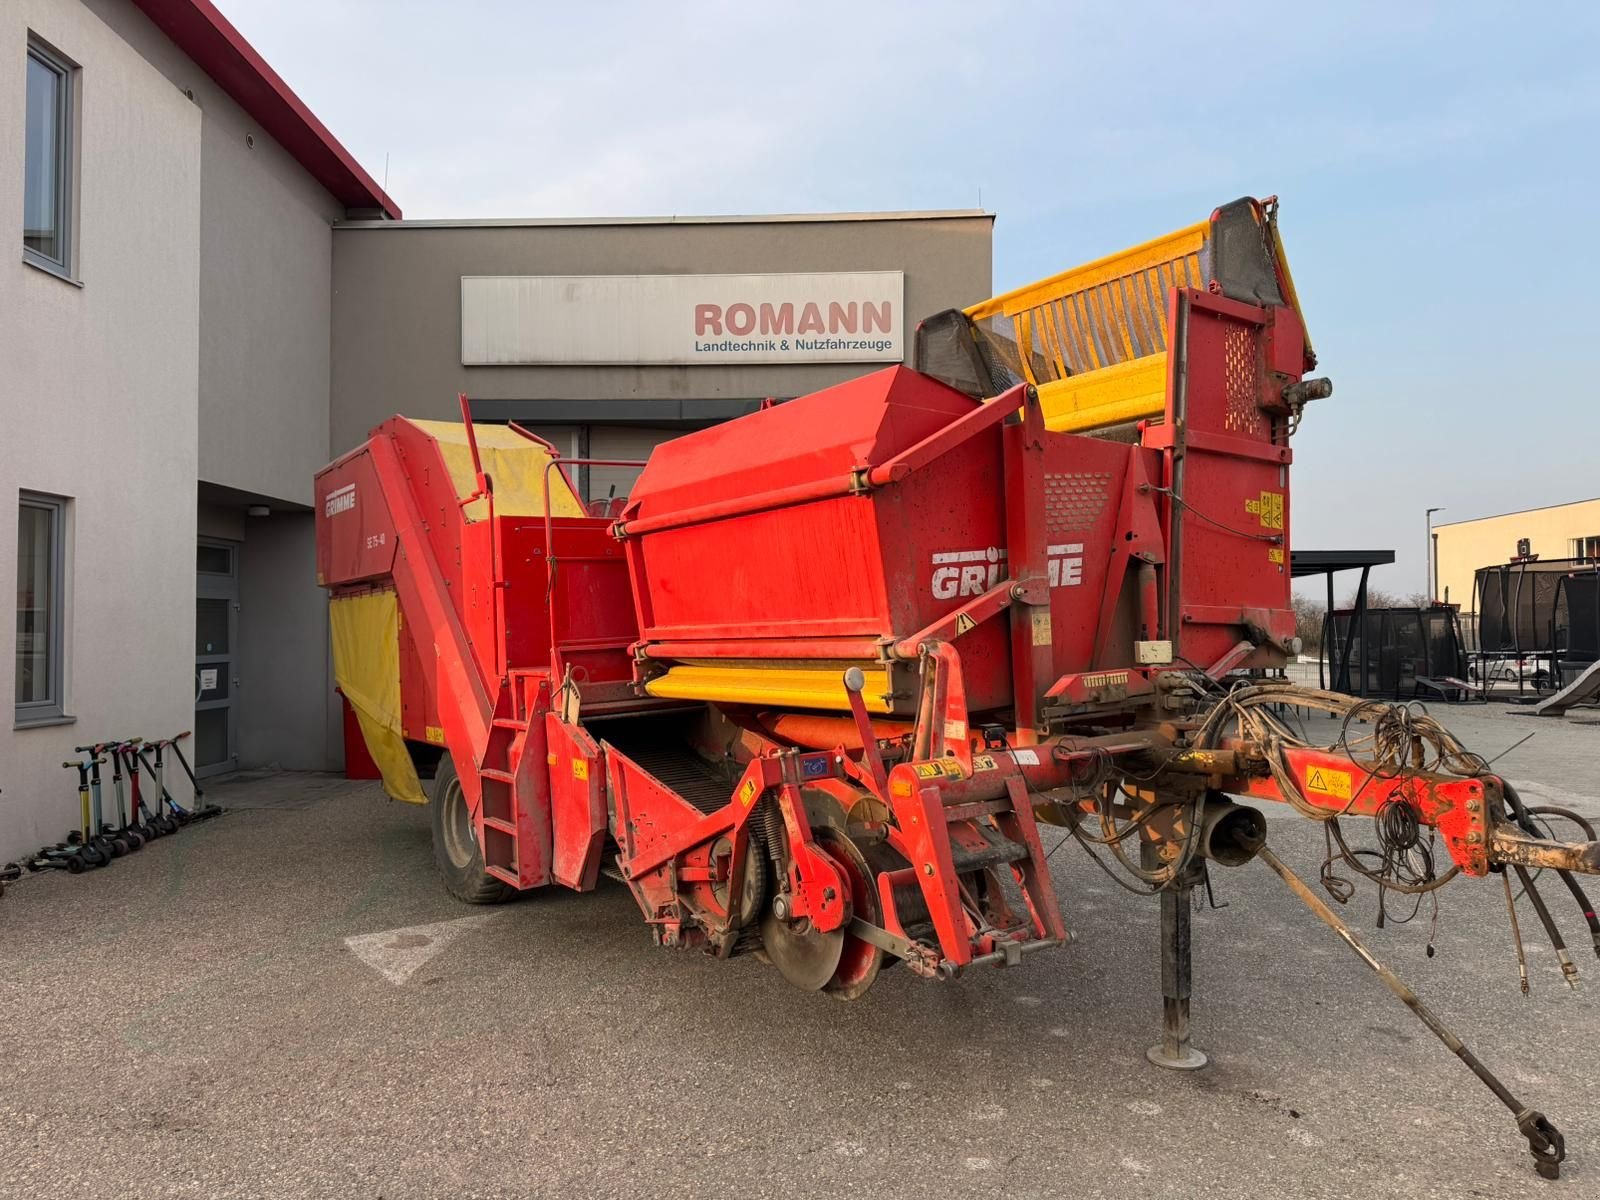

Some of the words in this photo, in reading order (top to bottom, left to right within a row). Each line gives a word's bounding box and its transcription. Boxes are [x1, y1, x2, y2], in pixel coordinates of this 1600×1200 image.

[694, 301, 892, 336] ROMANN
[695, 340, 776, 352] Landtechnik
[780, 340, 790, 351] &
[795, 339, 892, 351] Nutzfahrzeuge
[326, 488, 355, 518] GRIMME
[931, 545, 1083, 600] GRIE
